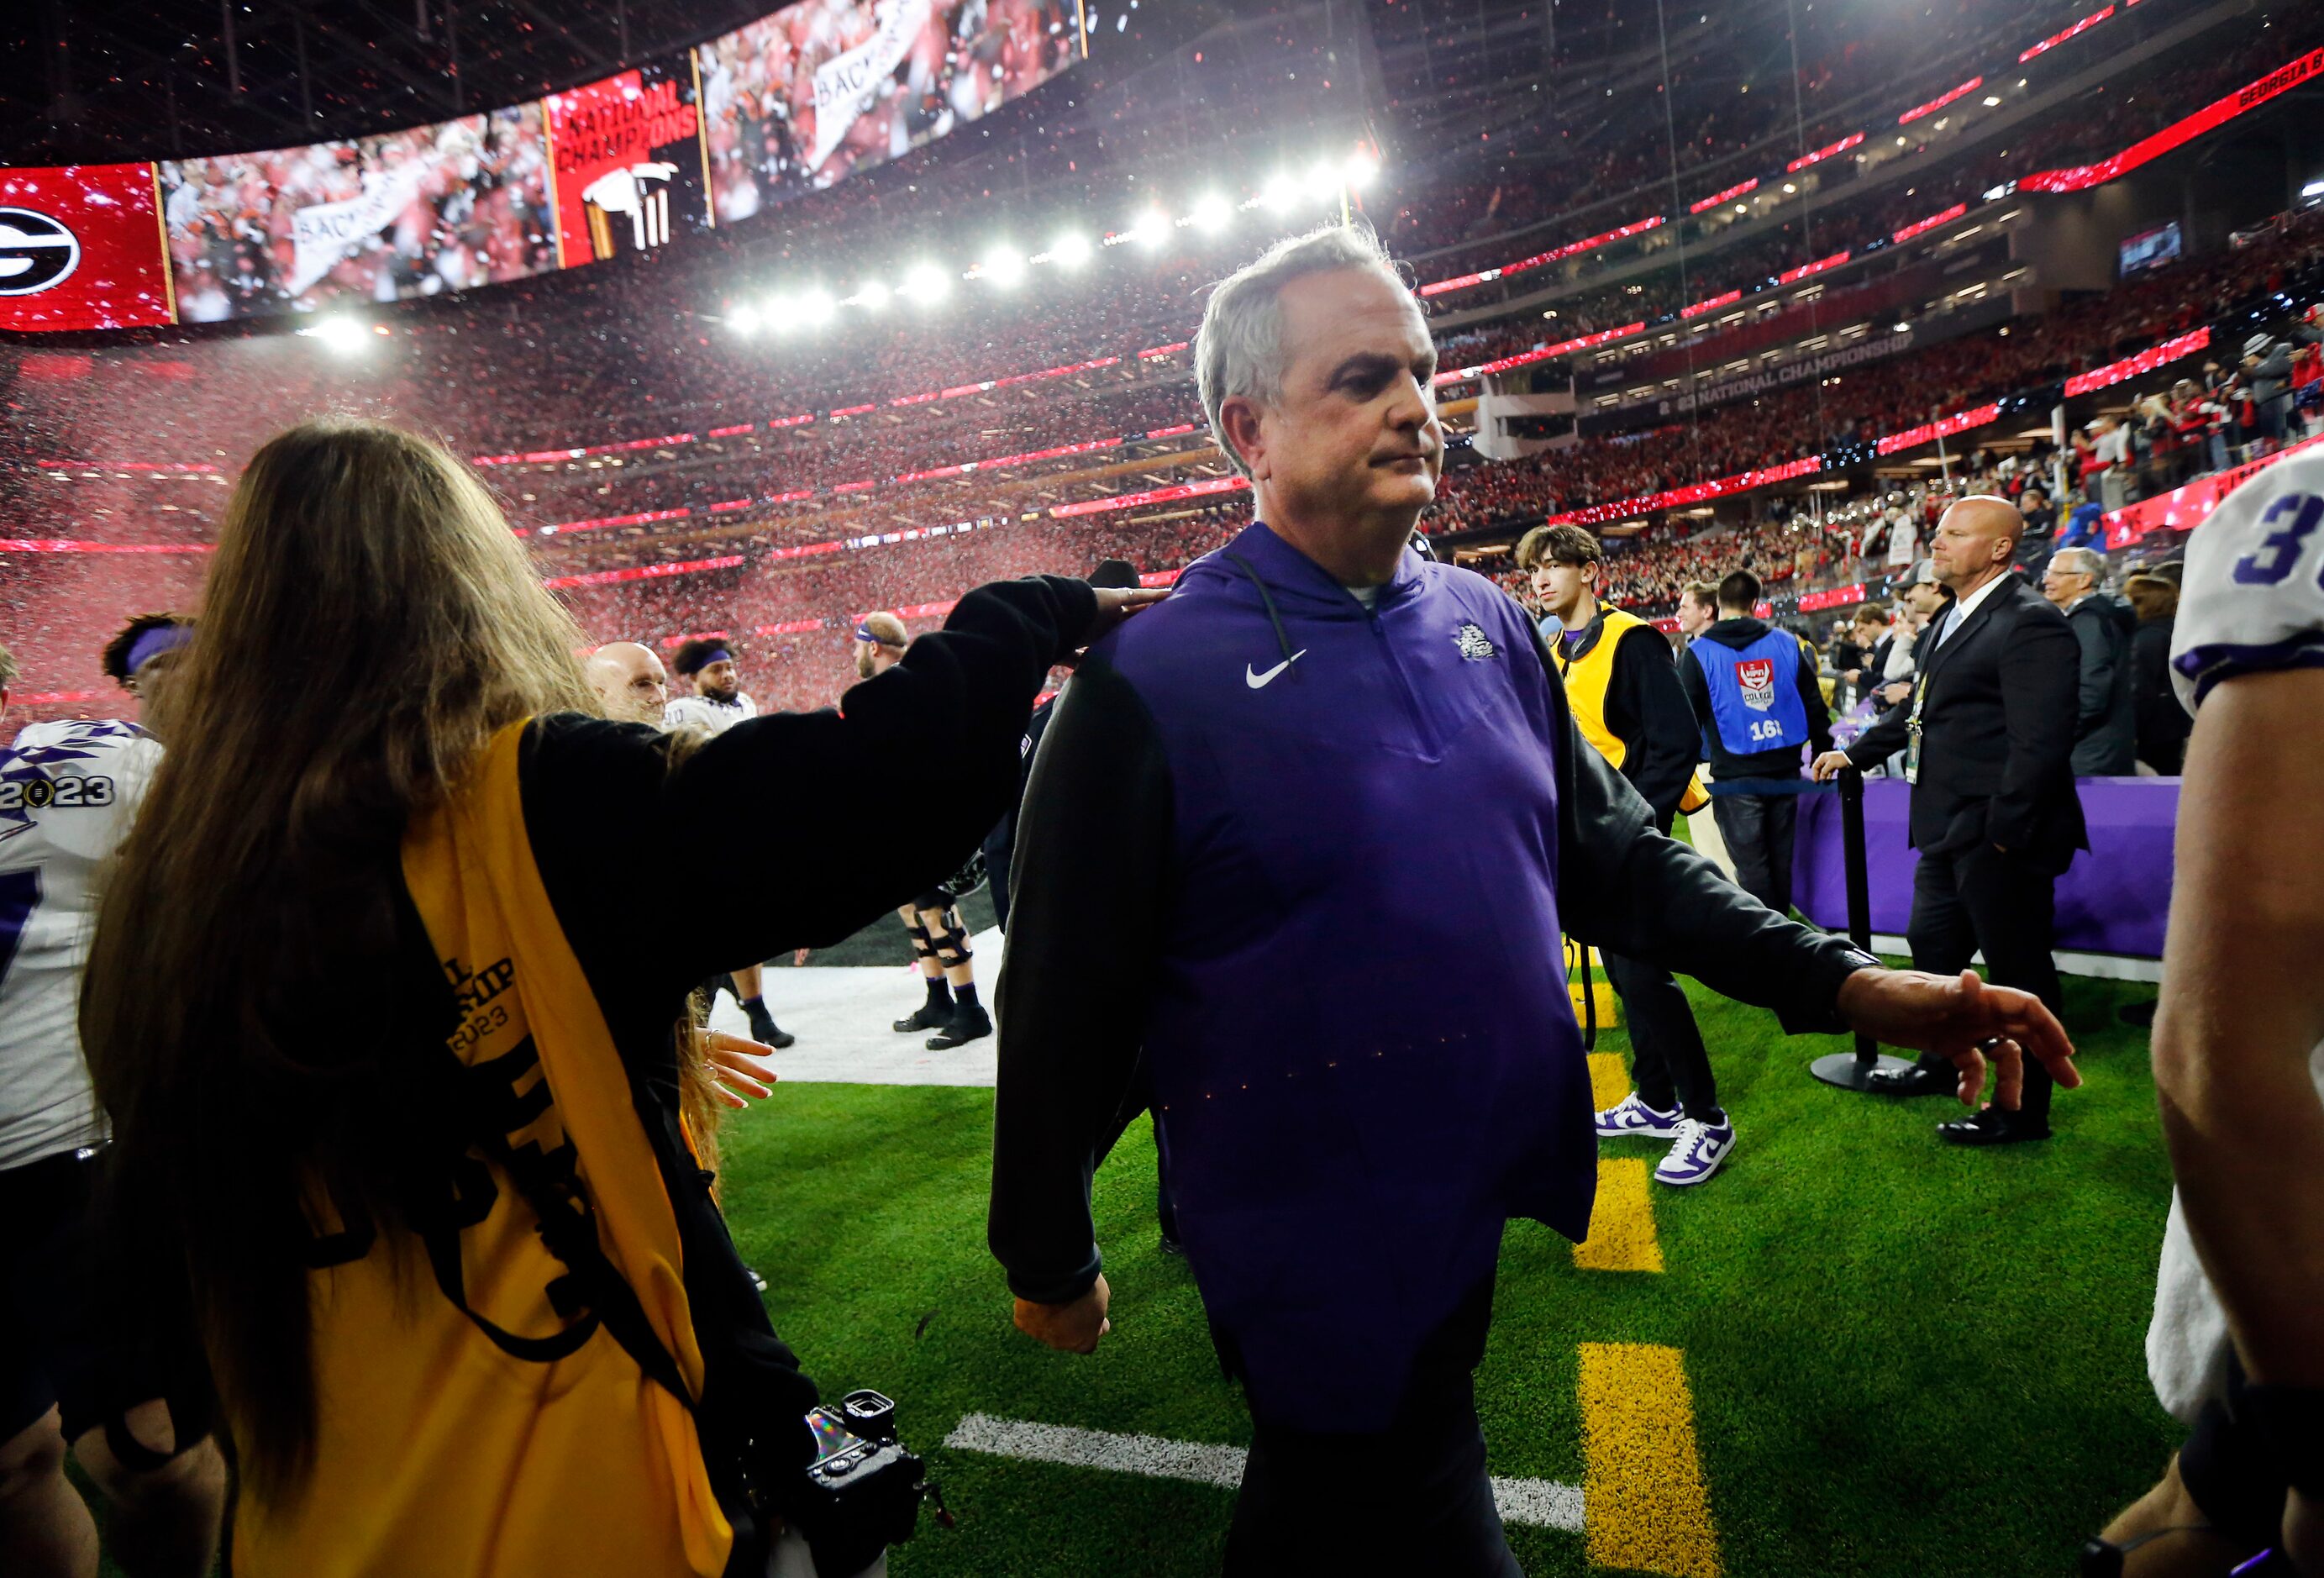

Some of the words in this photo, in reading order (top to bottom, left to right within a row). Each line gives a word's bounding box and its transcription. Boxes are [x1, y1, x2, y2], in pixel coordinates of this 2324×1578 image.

[2239, 61, 2308, 108] GEORGIA
[1698, 375, 1777, 407] NATIONAL
[1778, 332, 1915, 383] CHAMPIONSHIP
[454, 1005, 509, 1051] 2023
